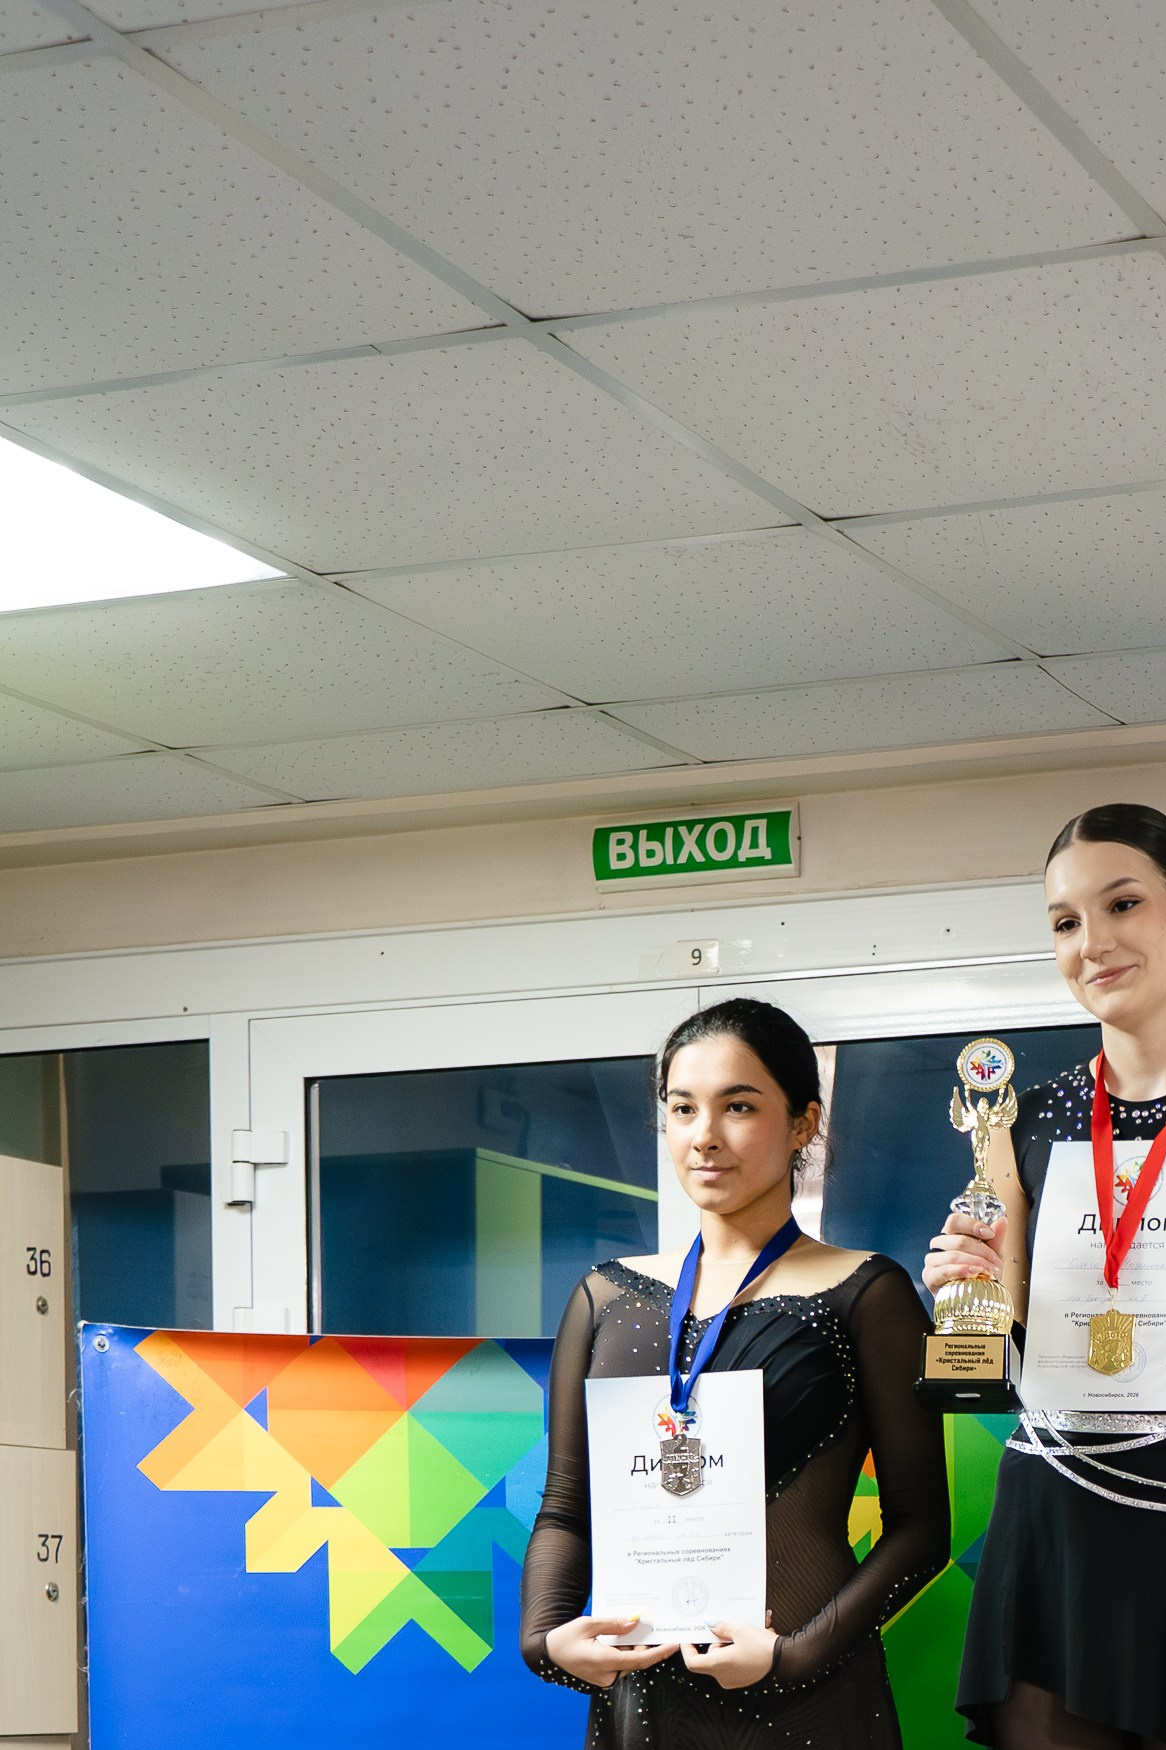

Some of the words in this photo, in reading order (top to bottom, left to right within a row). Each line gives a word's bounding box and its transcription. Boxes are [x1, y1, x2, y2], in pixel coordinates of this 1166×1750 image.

[608, 818, 772, 870] ВЫХОД
[691, 948, 702, 966] 9
[26, 1247, 51, 1277] 36
[37, 1533, 63, 1564] 37
